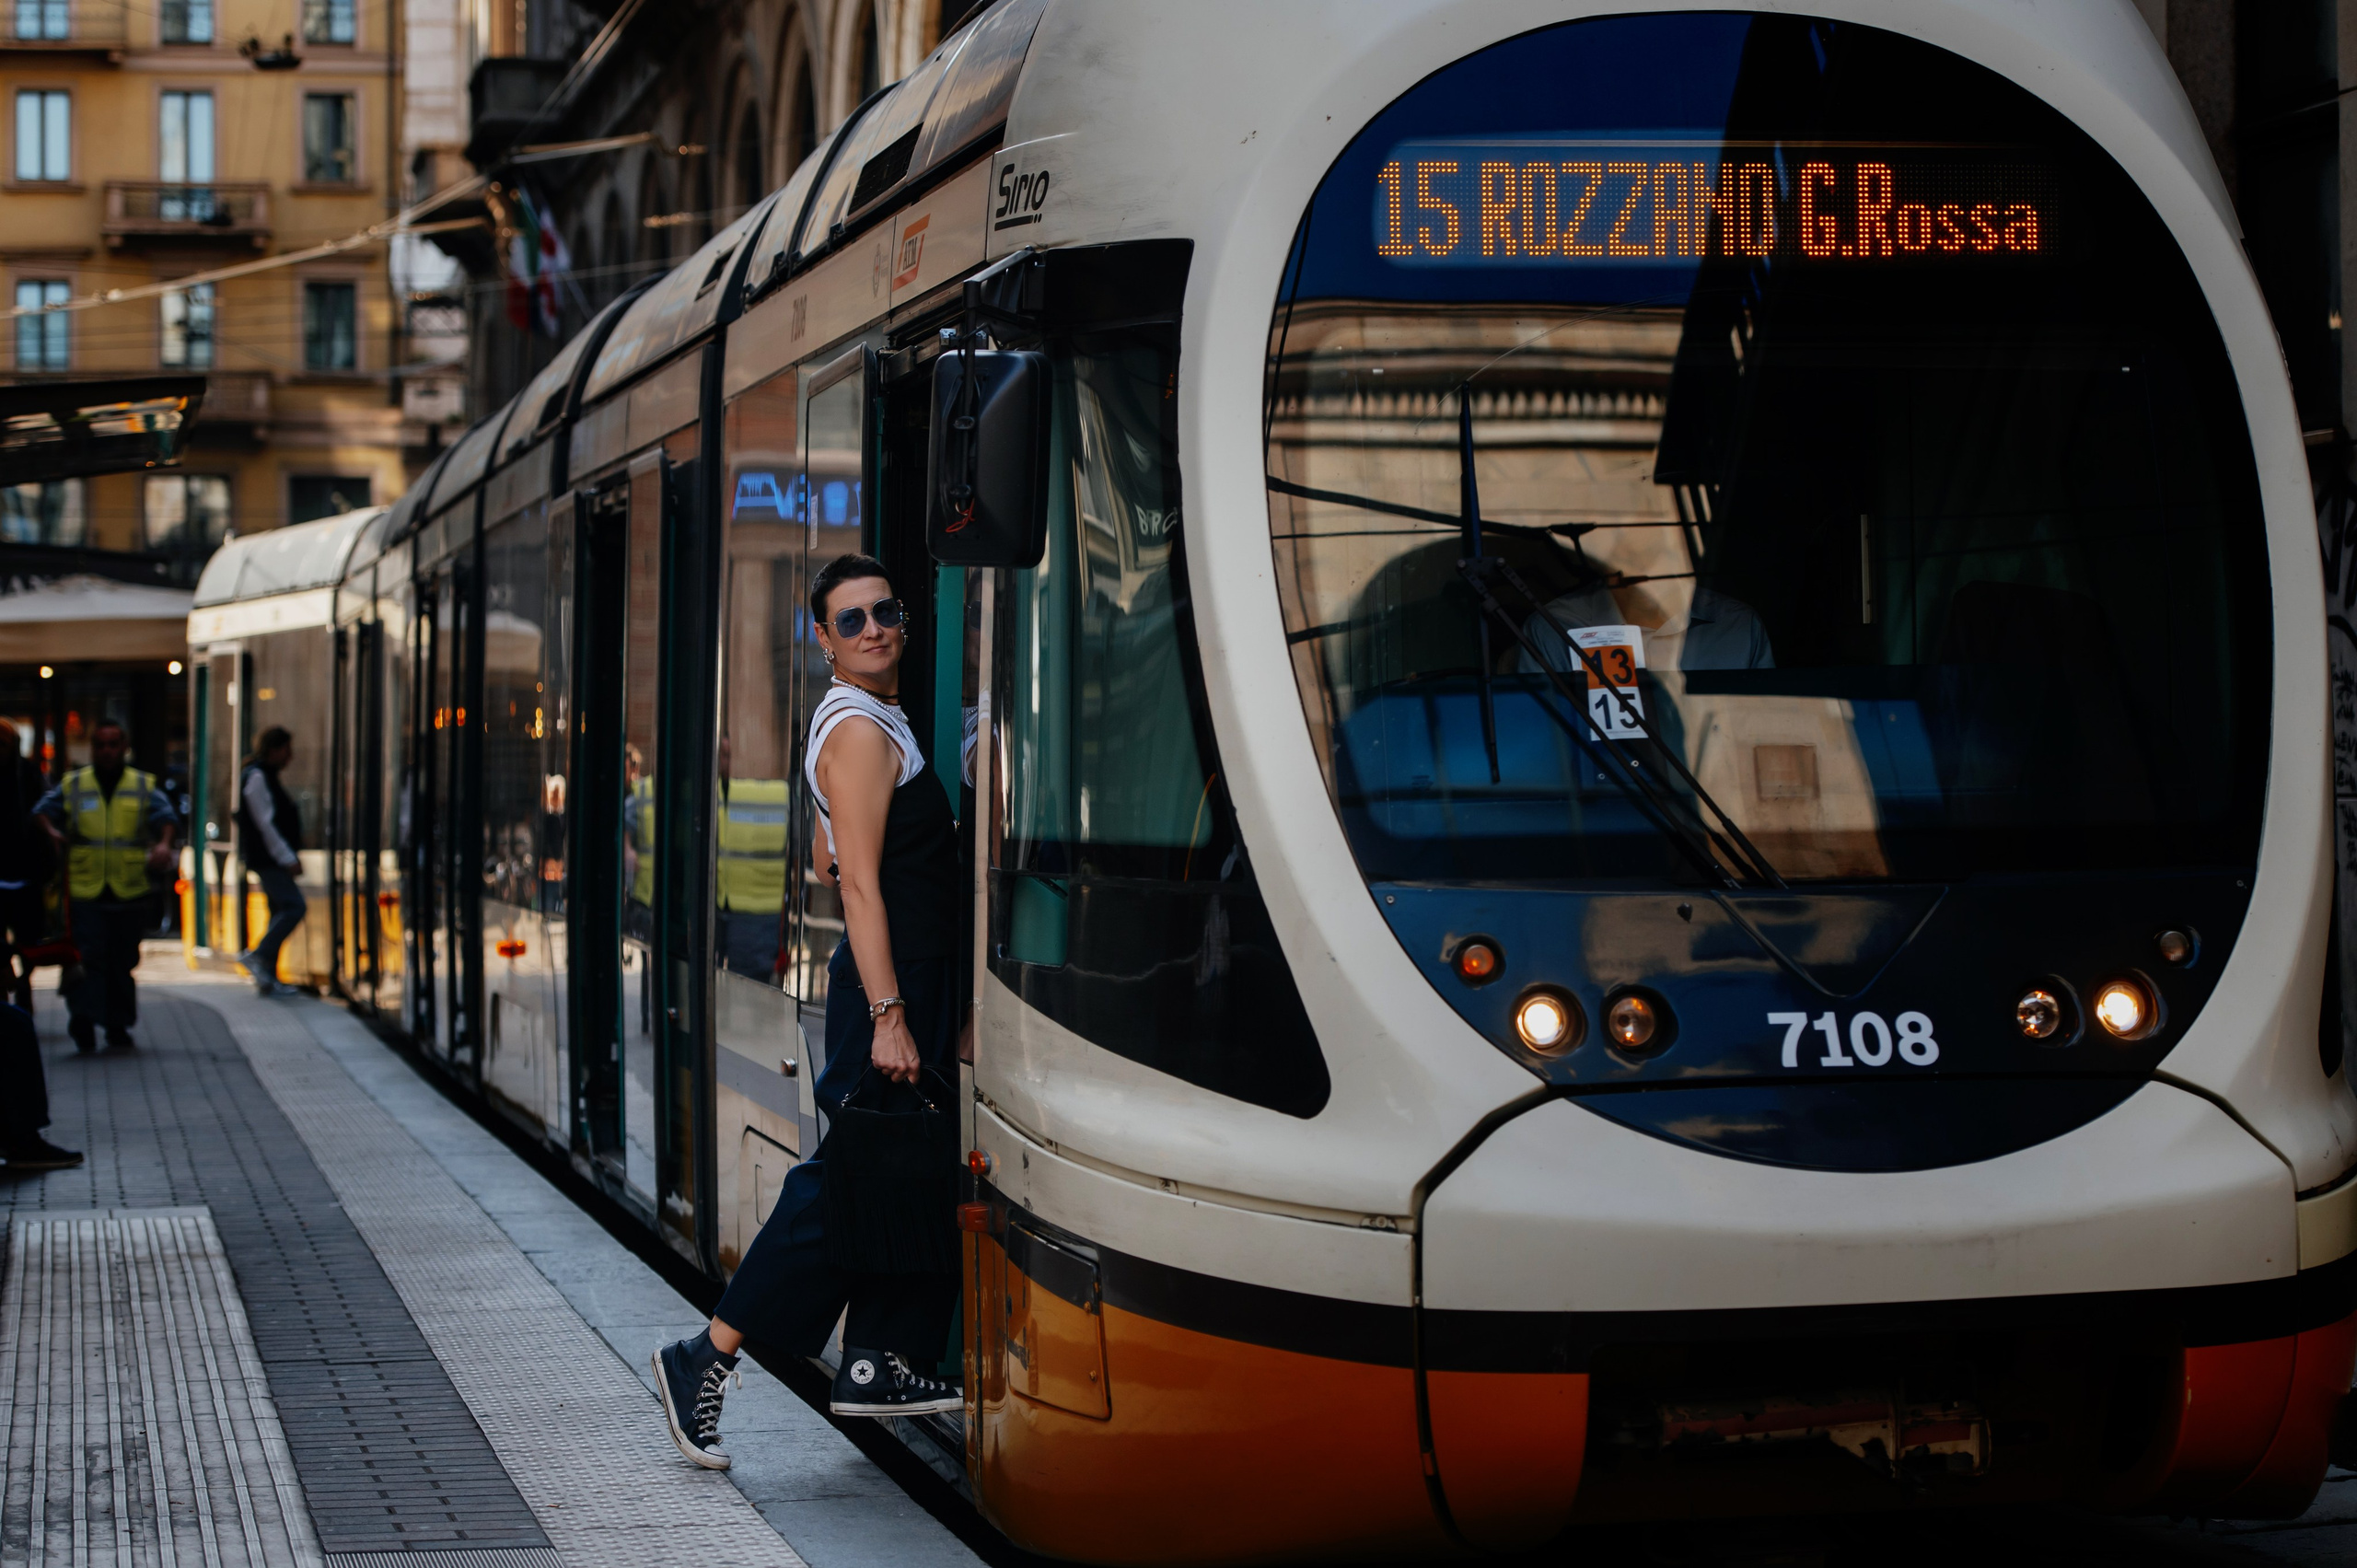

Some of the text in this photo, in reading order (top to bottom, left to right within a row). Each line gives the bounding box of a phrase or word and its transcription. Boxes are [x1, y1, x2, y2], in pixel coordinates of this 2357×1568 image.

[1377, 161, 2039, 256] 15 ROZZANO G.Rossa
[902, 236, 919, 272] ATM
[1587, 648, 1633, 686] 13
[1595, 693, 1641, 730] 15
[1767, 1011, 1940, 1068] 7108
